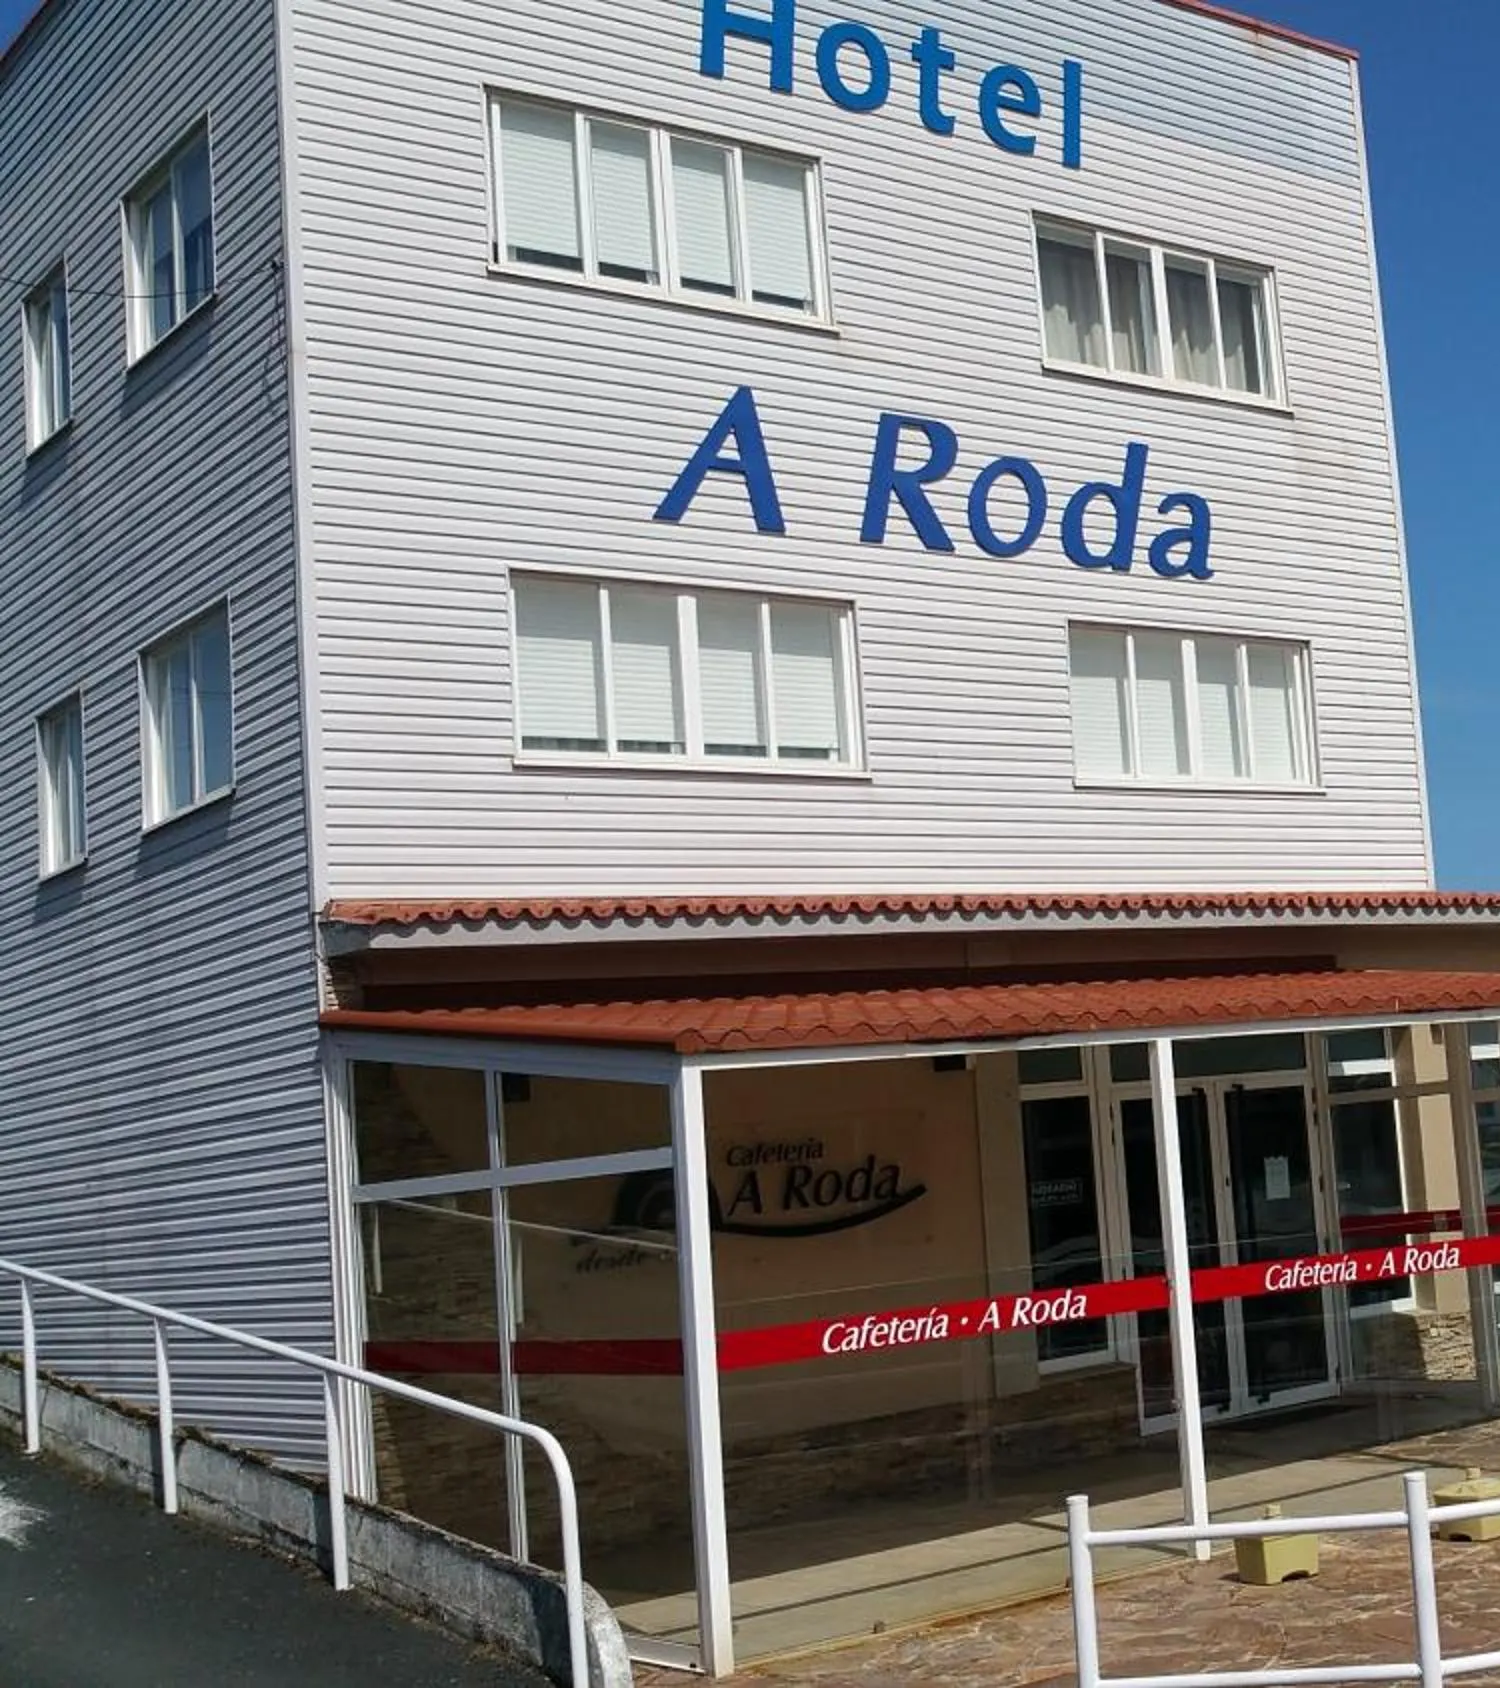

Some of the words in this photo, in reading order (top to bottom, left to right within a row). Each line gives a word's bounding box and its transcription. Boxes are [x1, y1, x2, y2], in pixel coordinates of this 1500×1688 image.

[699, 0, 1082, 170] Hotel
[652, 385, 786, 536] A
[859, 411, 1216, 580] Roda
[727, 1170, 763, 1217] A
[782, 1153, 901, 1211] Roda
[1264, 1254, 1358, 1292] Cafetería
[1379, 1251, 1396, 1277] A
[1404, 1243, 1461, 1274] Roda
[821, 1306, 950, 1354] Cafetería
[977, 1301, 1001, 1333] A
[1011, 1288, 1088, 1327] Roda
